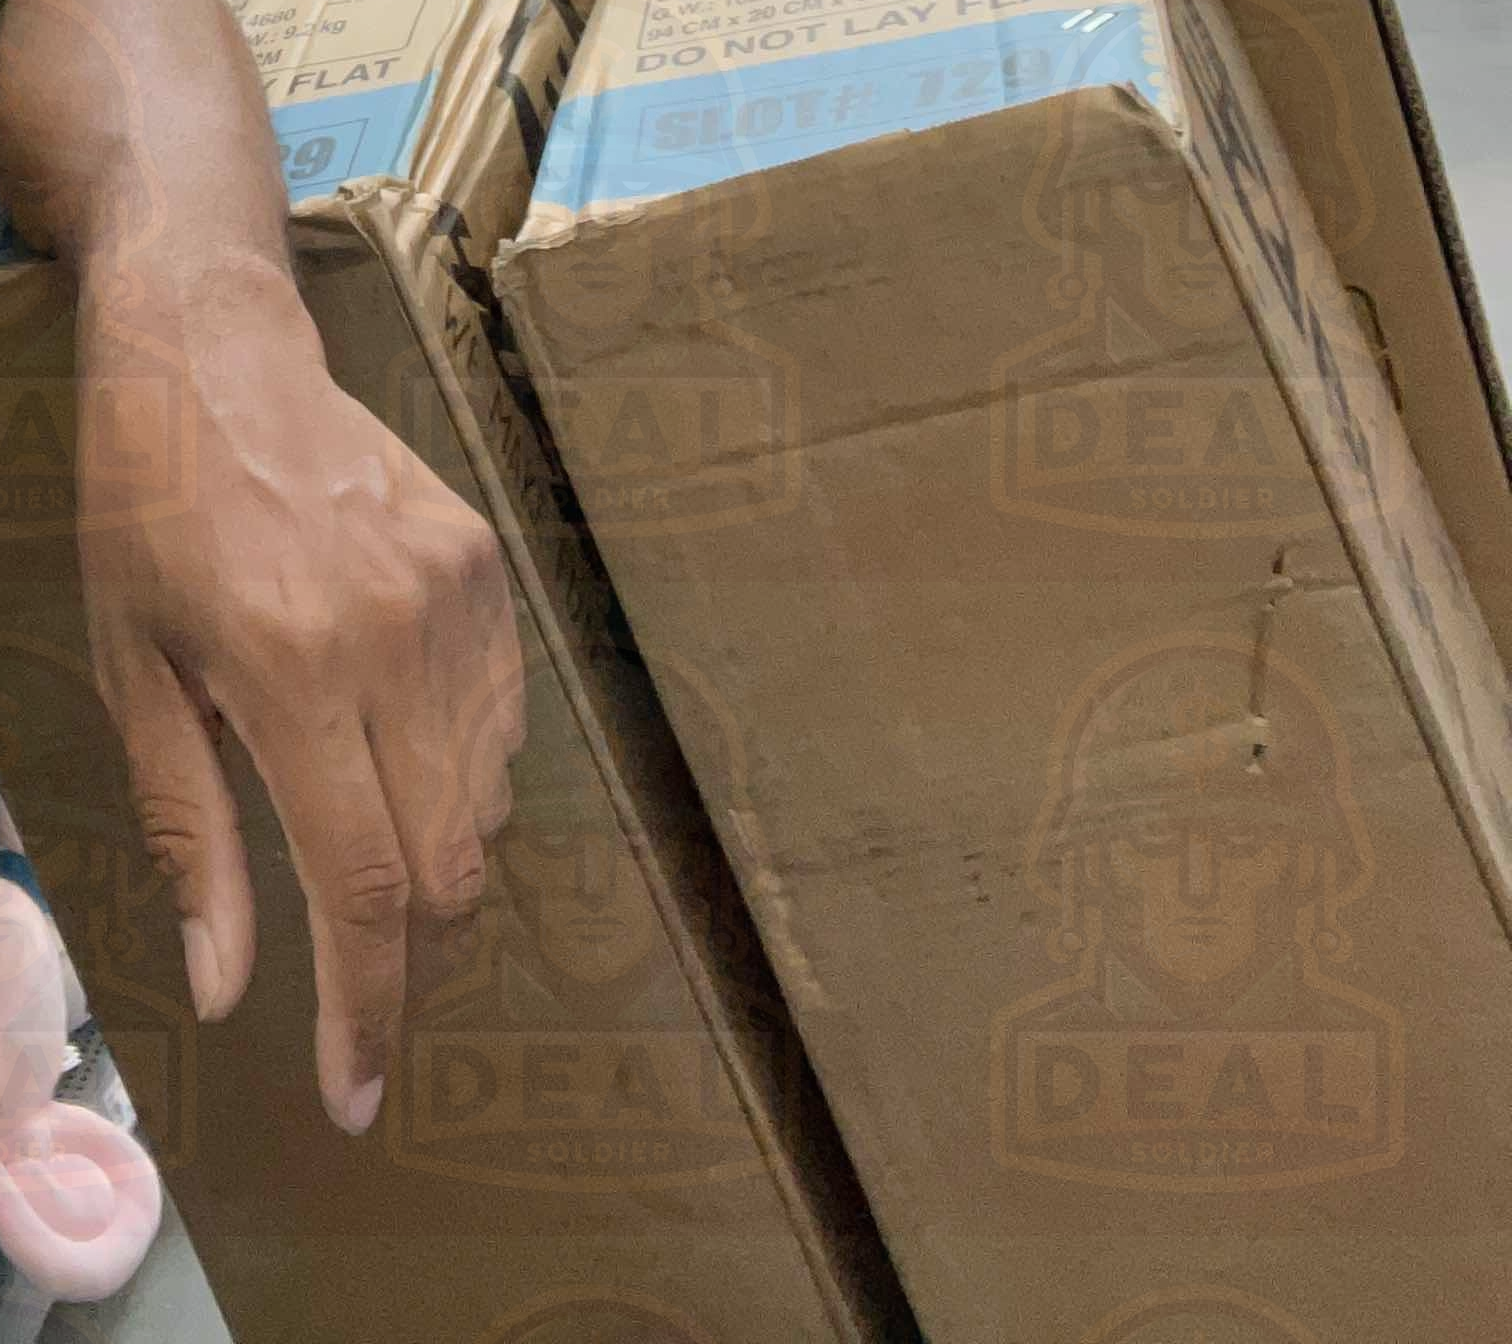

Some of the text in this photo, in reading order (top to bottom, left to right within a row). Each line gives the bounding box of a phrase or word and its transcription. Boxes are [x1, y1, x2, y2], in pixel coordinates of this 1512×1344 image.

[319, 19, 347, 35] kg
[635, 46, 706, 74] DO
[723, 23, 827, 59] NOT
[844, 1, 938, 36] LAY
[681, 15, 721, 35] CM
[287, 56, 401, 96] FLAT
[652, 48, 1054, 153] SLOT# 729
